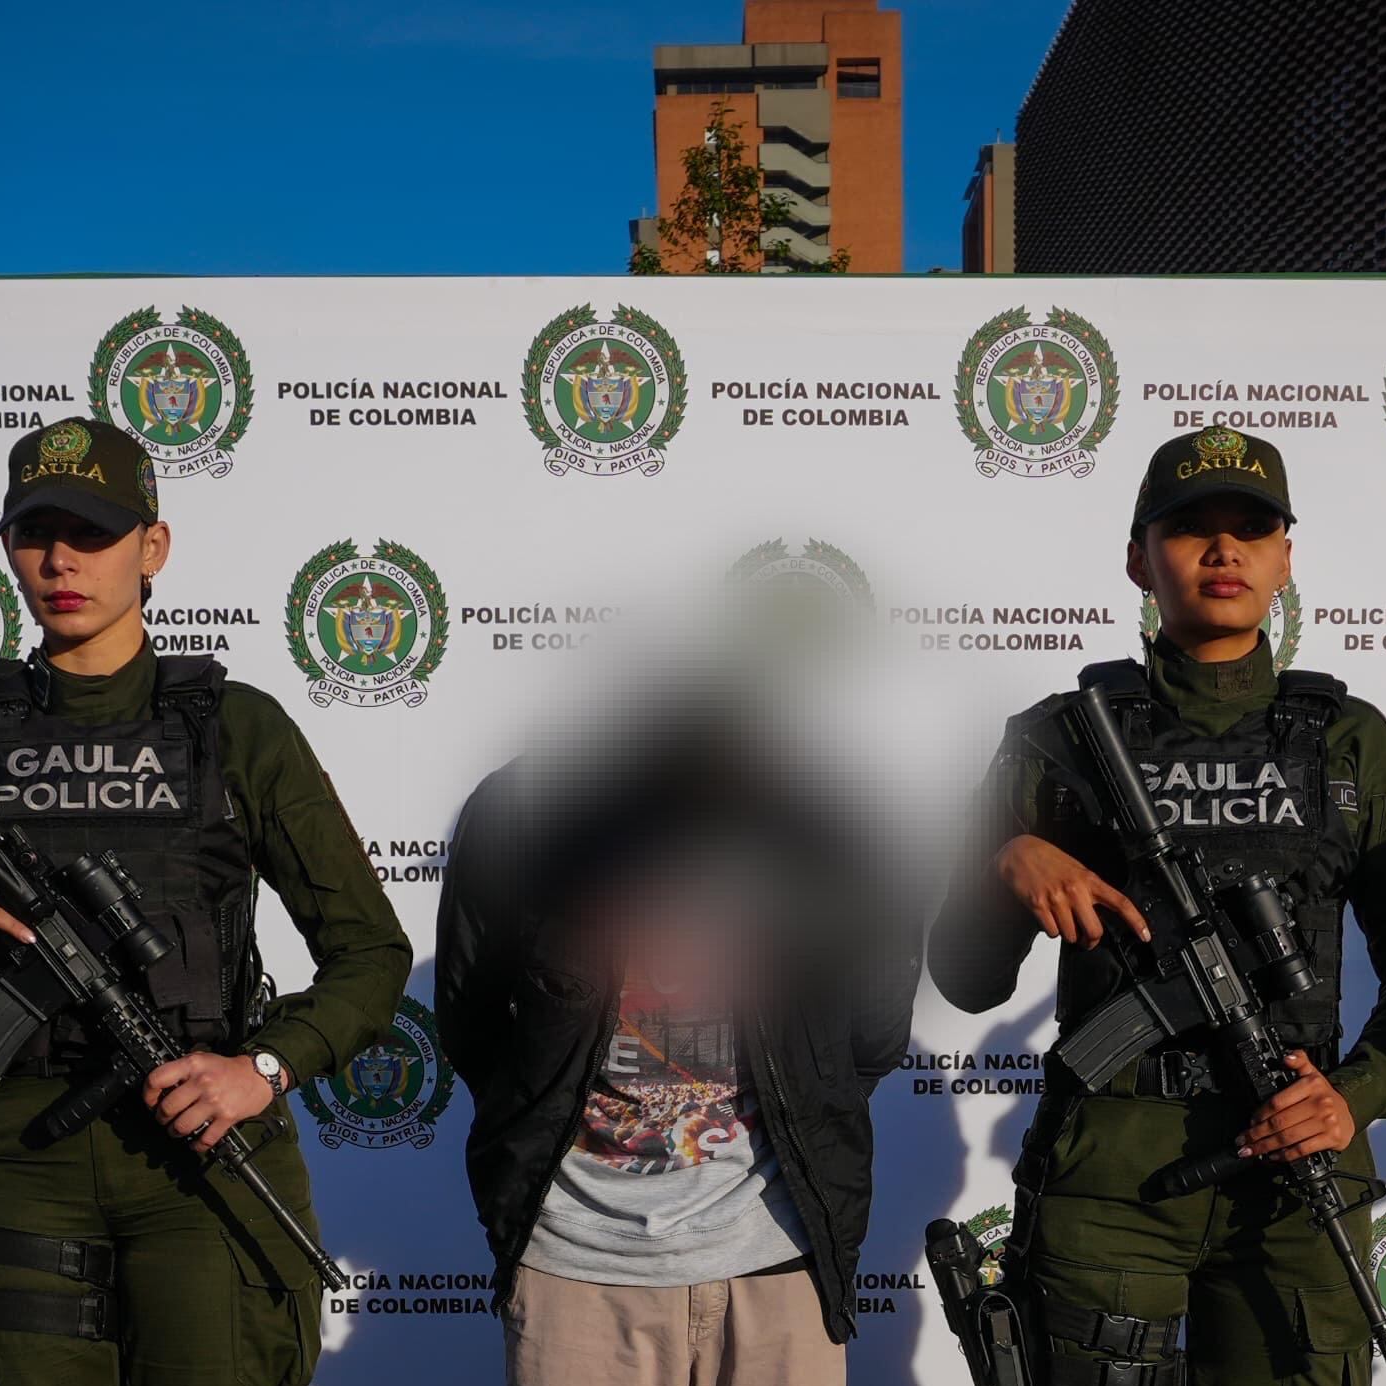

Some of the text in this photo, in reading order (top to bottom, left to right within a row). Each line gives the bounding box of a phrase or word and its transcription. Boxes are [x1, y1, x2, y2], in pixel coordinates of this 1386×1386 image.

[543, 326, 665, 384] REPUBLICA DE COLOMBIA
[278, 382, 507, 399] POLICÍA NACIONAL
[712, 379, 940, 399] POLICÍA NACIONAL
[1144, 381, 1369, 401] POLICÍA NACIONAL
[311, 409, 476, 425] DE COLOMBIA
[744, 409, 909, 425] DE COLOMBIA
[1173, 410, 1339, 429] DE COLOMBIA
[557, 423, 655, 452] POLICIA NACIONAL
[554, 449, 656, 472] DIOS Y PATRIA
[1177, 459, 1268, 480] GAULA
[21, 463, 107, 484] GAULA
[306, 560, 427, 618] REPUBLICA DE COLOMBIA
[462, 604, 556, 624] POLICÍA
[994, 608, 1114, 624] NACIONAL
[153, 633, 229, 651] OMBIA
[493, 634, 522, 649] DE
[960, 634, 1083, 650] COLOMBIA
[1345, 635, 1373, 650] DE
[320, 655, 418, 685] POLICIA NACIONAL
[319, 681, 419, 703] DIOS Y PATRIA
[7, 744, 164, 777] GAULA
[1159, 791, 1305, 828] OLICÍA
[899, 1050, 976, 1071] OLICÍA
[914, 1078, 1045, 1095] DE COLOMB
[856, 1273, 926, 1290] IONAL
[330, 1298, 487, 1315] DE COLOMBIA
